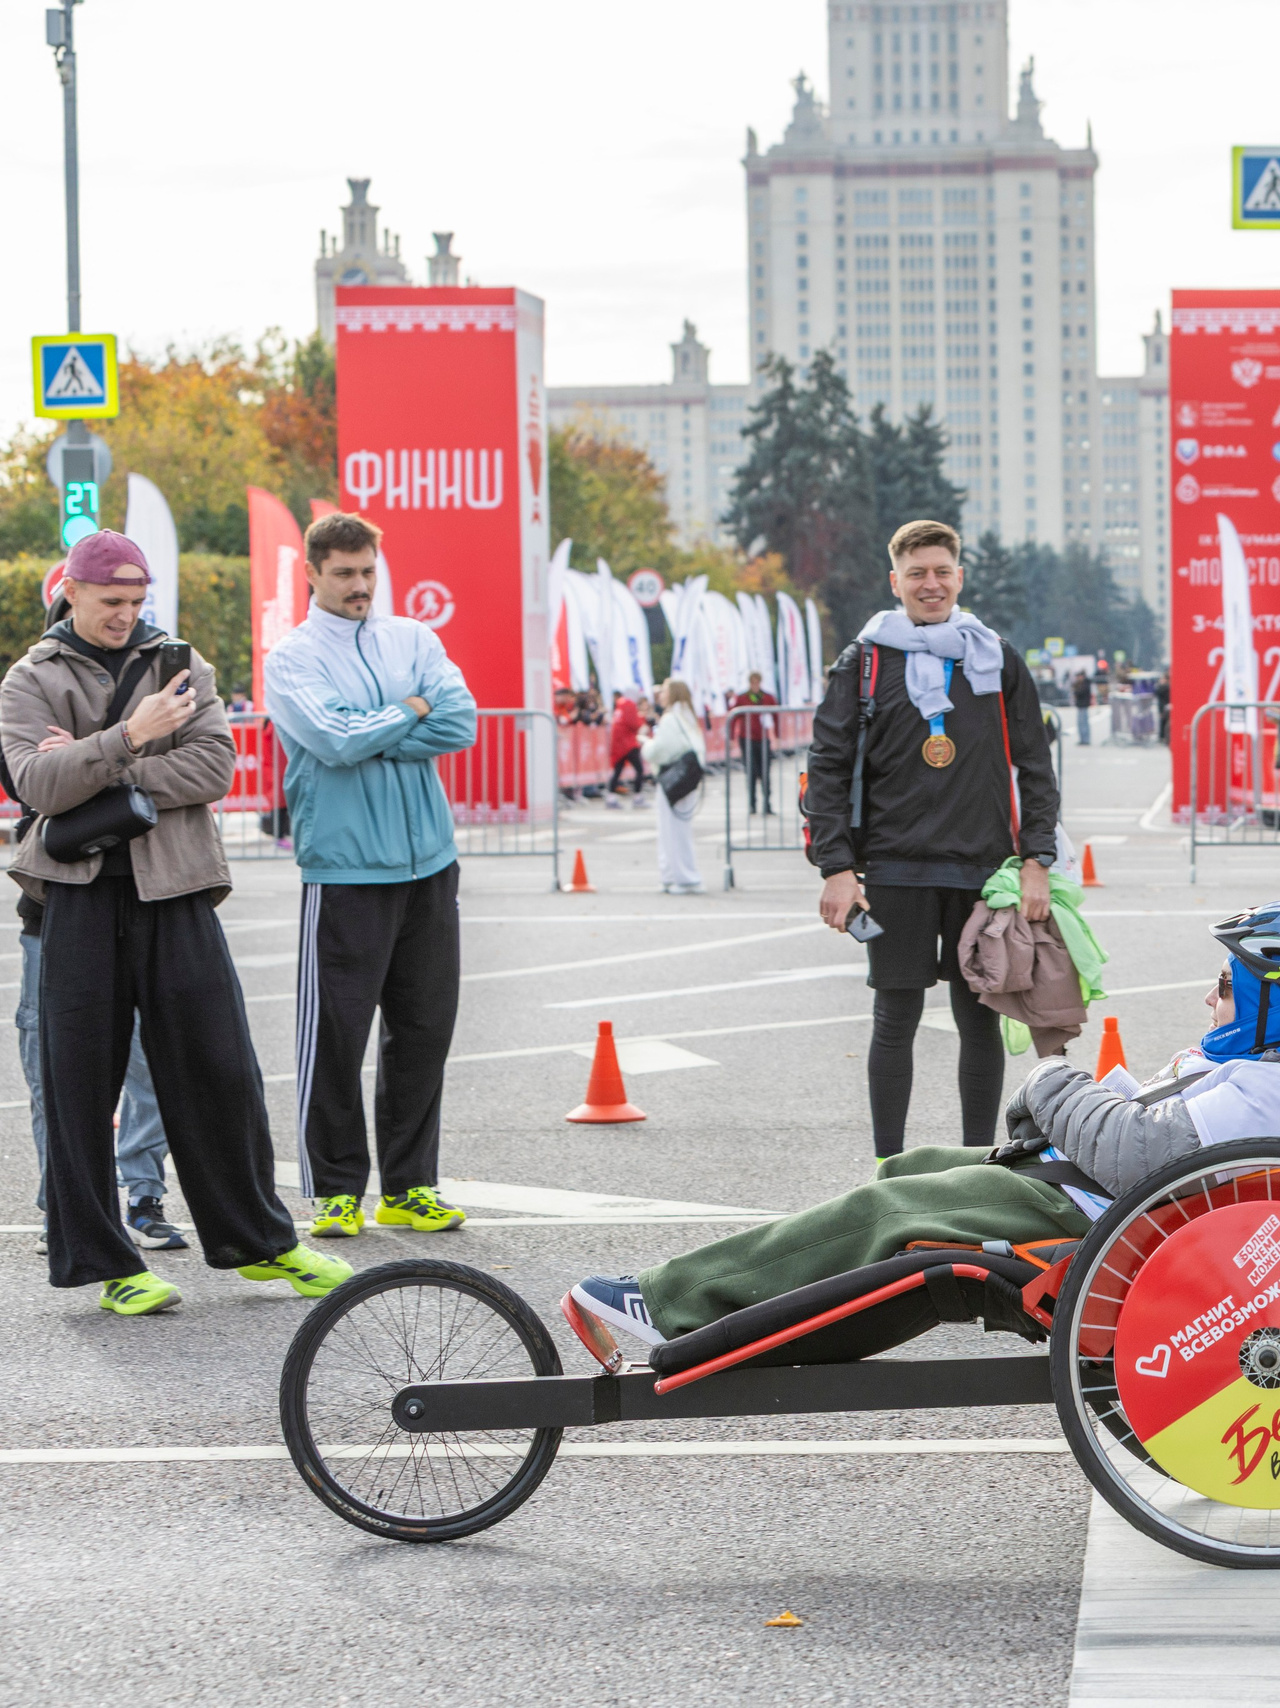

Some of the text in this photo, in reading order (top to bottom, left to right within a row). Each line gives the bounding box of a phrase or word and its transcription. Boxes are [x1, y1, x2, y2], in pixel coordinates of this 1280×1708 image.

[65, 481, 99, 515] 27
[344, 448, 503, 510] ФИНИШ
[1238, 1216, 1279, 1263] БОЛЬШЕ
[1252, 1237, 1275, 1262] ЧЕМ
[1169, 1295, 1238, 1349] МАГНИТ
